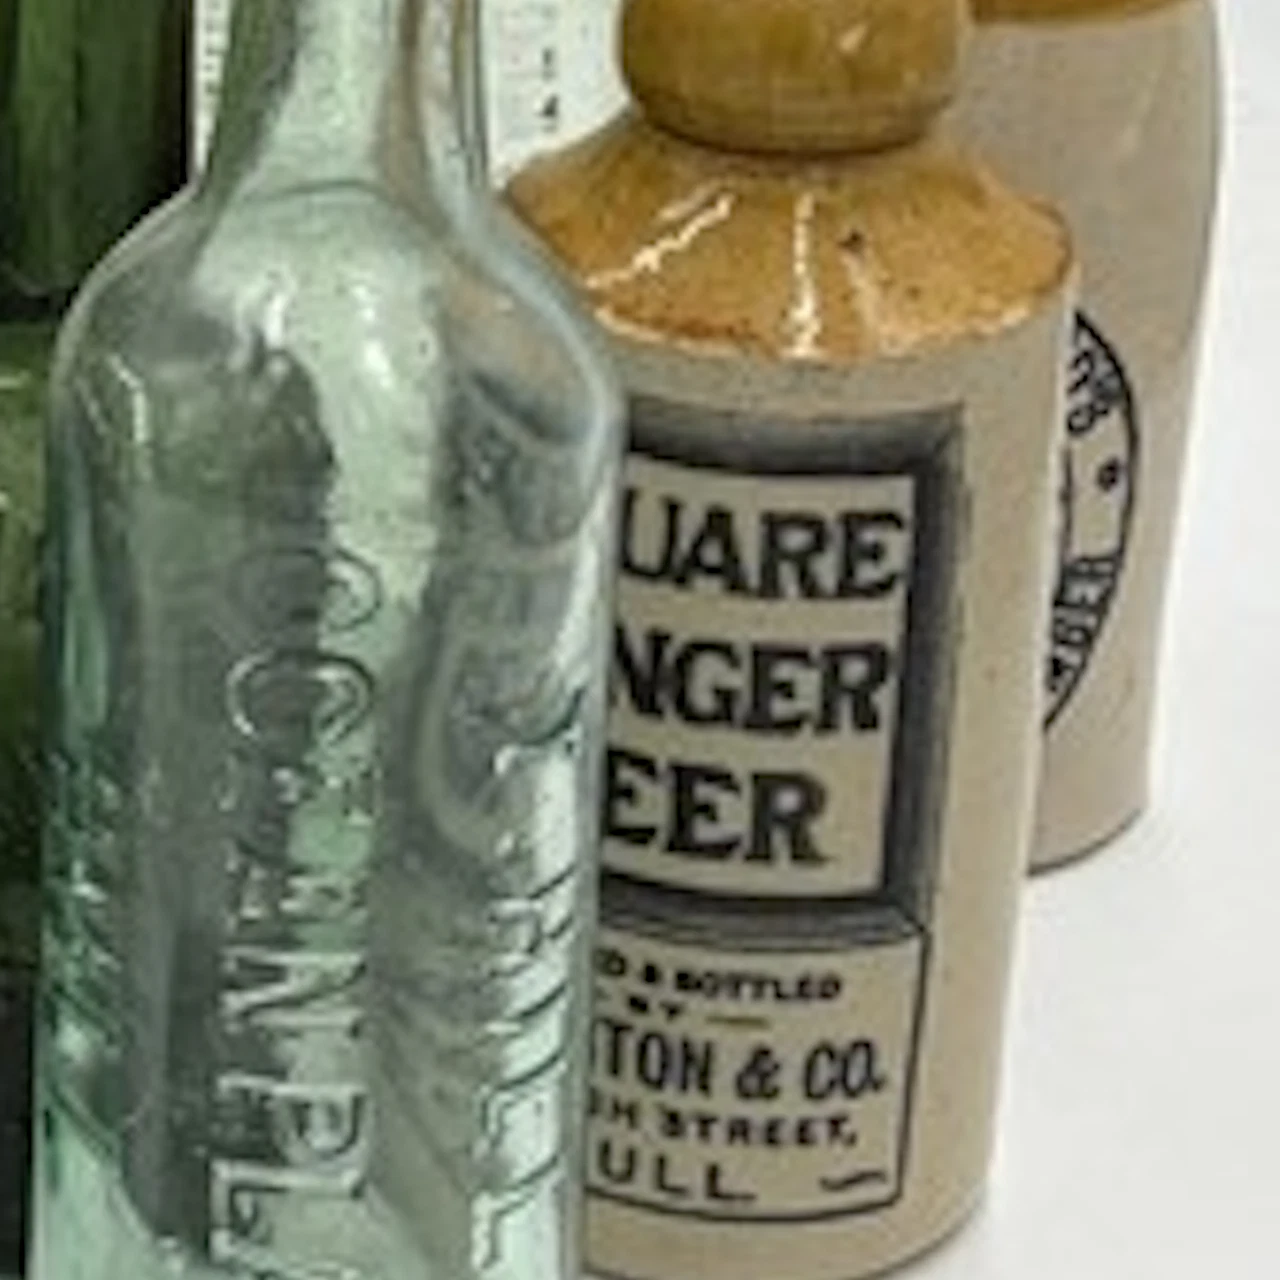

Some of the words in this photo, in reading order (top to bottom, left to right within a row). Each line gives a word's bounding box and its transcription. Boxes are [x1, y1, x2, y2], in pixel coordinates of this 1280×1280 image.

[619, 485, 906, 600] UARE
[610, 621, 890, 733] NGER
[606, 748, 838, 866] EER
[674, 968, 843, 1002] BOTTLED
[595, 1018, 714, 1100] TON
[736, 1046, 782, 1102] &
[597, 1139, 758, 1203] ULL
